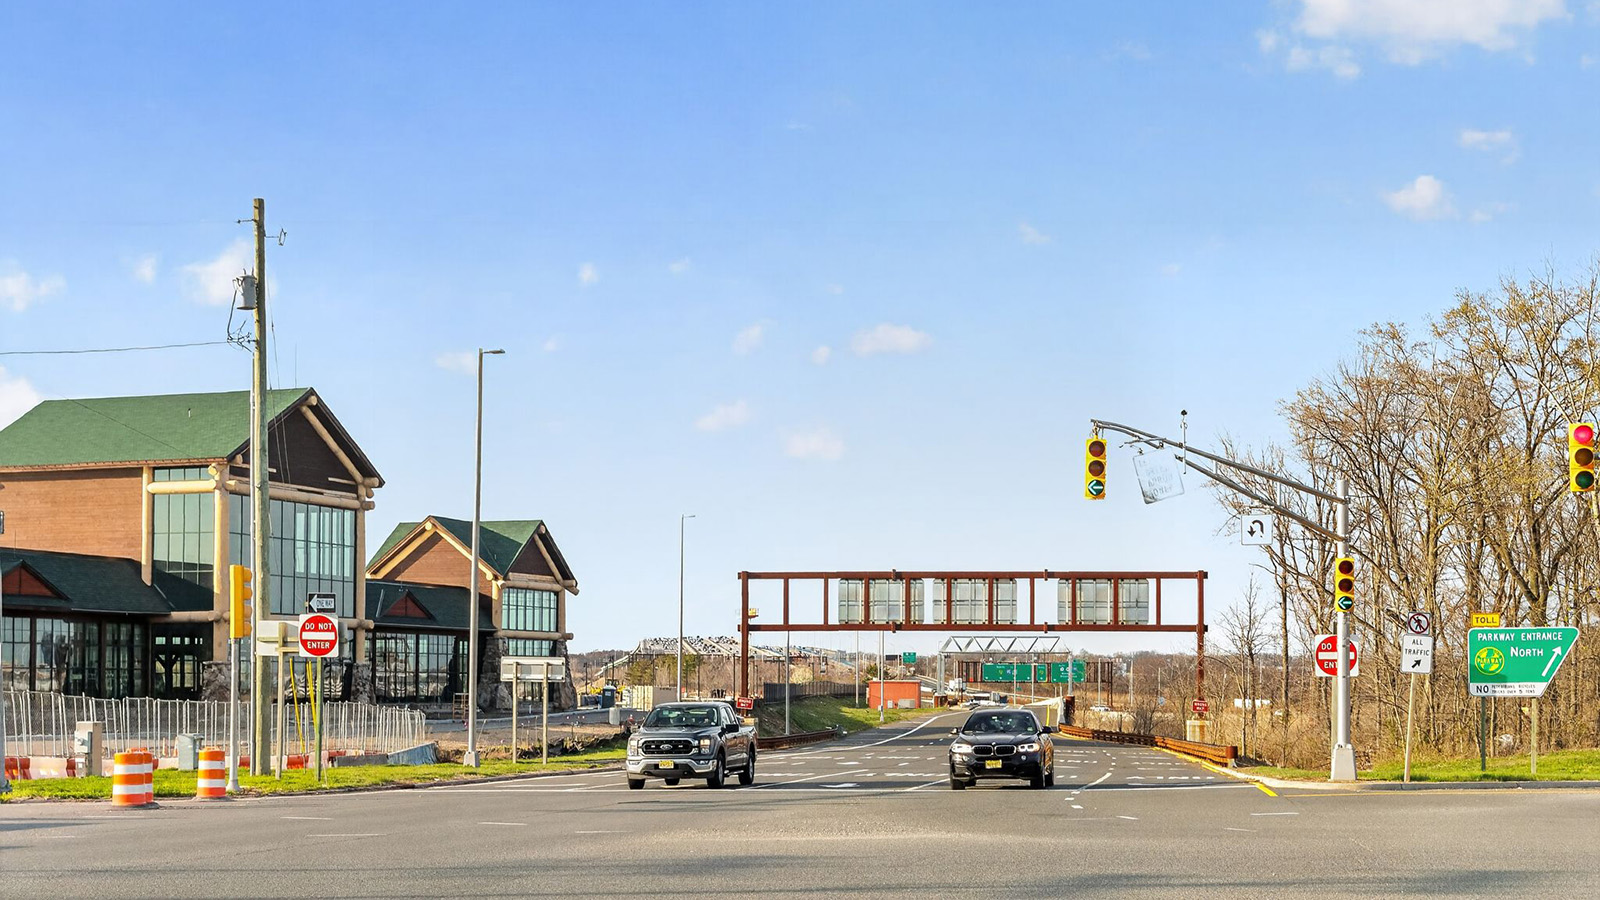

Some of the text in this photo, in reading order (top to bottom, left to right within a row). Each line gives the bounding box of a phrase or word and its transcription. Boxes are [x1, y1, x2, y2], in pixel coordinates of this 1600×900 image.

[1475, 616, 1497, 624] TOLL
[305, 622, 332, 630] DO NOT
[1478, 631, 1563, 641] PARKWAY ENTRANCE
[307, 641, 330, 649] ENTER
[1321, 642, 1332, 650] DO
[1405, 648, 1430, 656] TRAFFIC
[1476, 685, 1489, 693] NO
